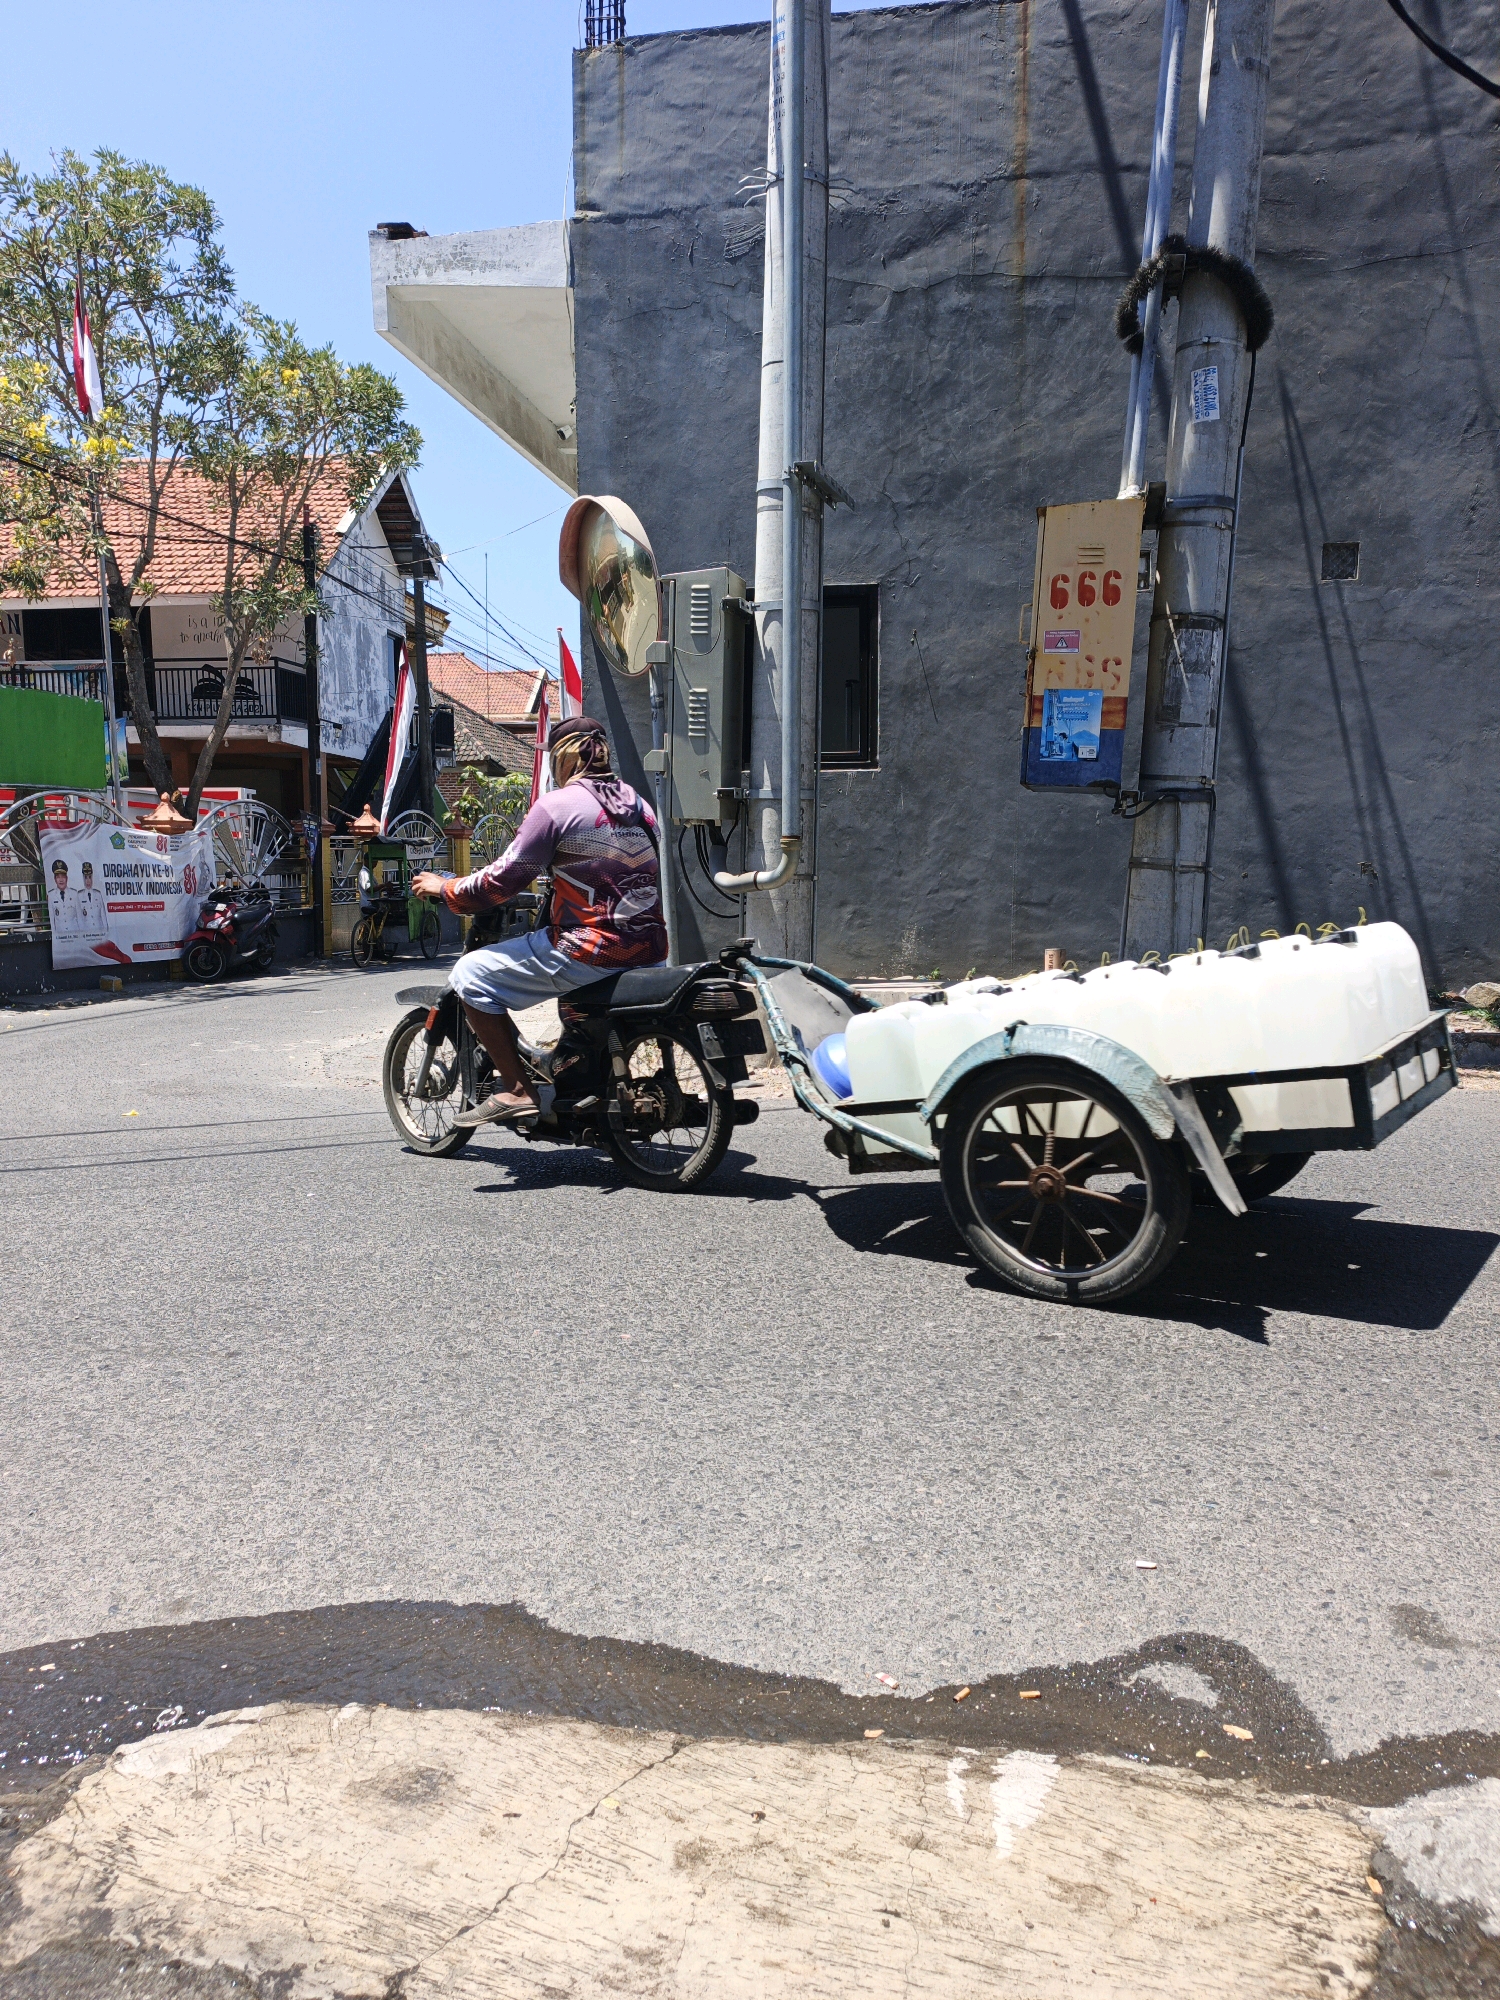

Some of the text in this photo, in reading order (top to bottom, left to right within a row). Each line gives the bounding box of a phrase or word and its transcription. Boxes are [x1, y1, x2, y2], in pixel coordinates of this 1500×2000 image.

[1193, 371, 1199, 387] WC
[1050, 569, 1122, 610] 666
[103, 863, 151, 878] DIRGAHAYU
[105, 881, 183, 896] REPUBLIK INDONESIA
